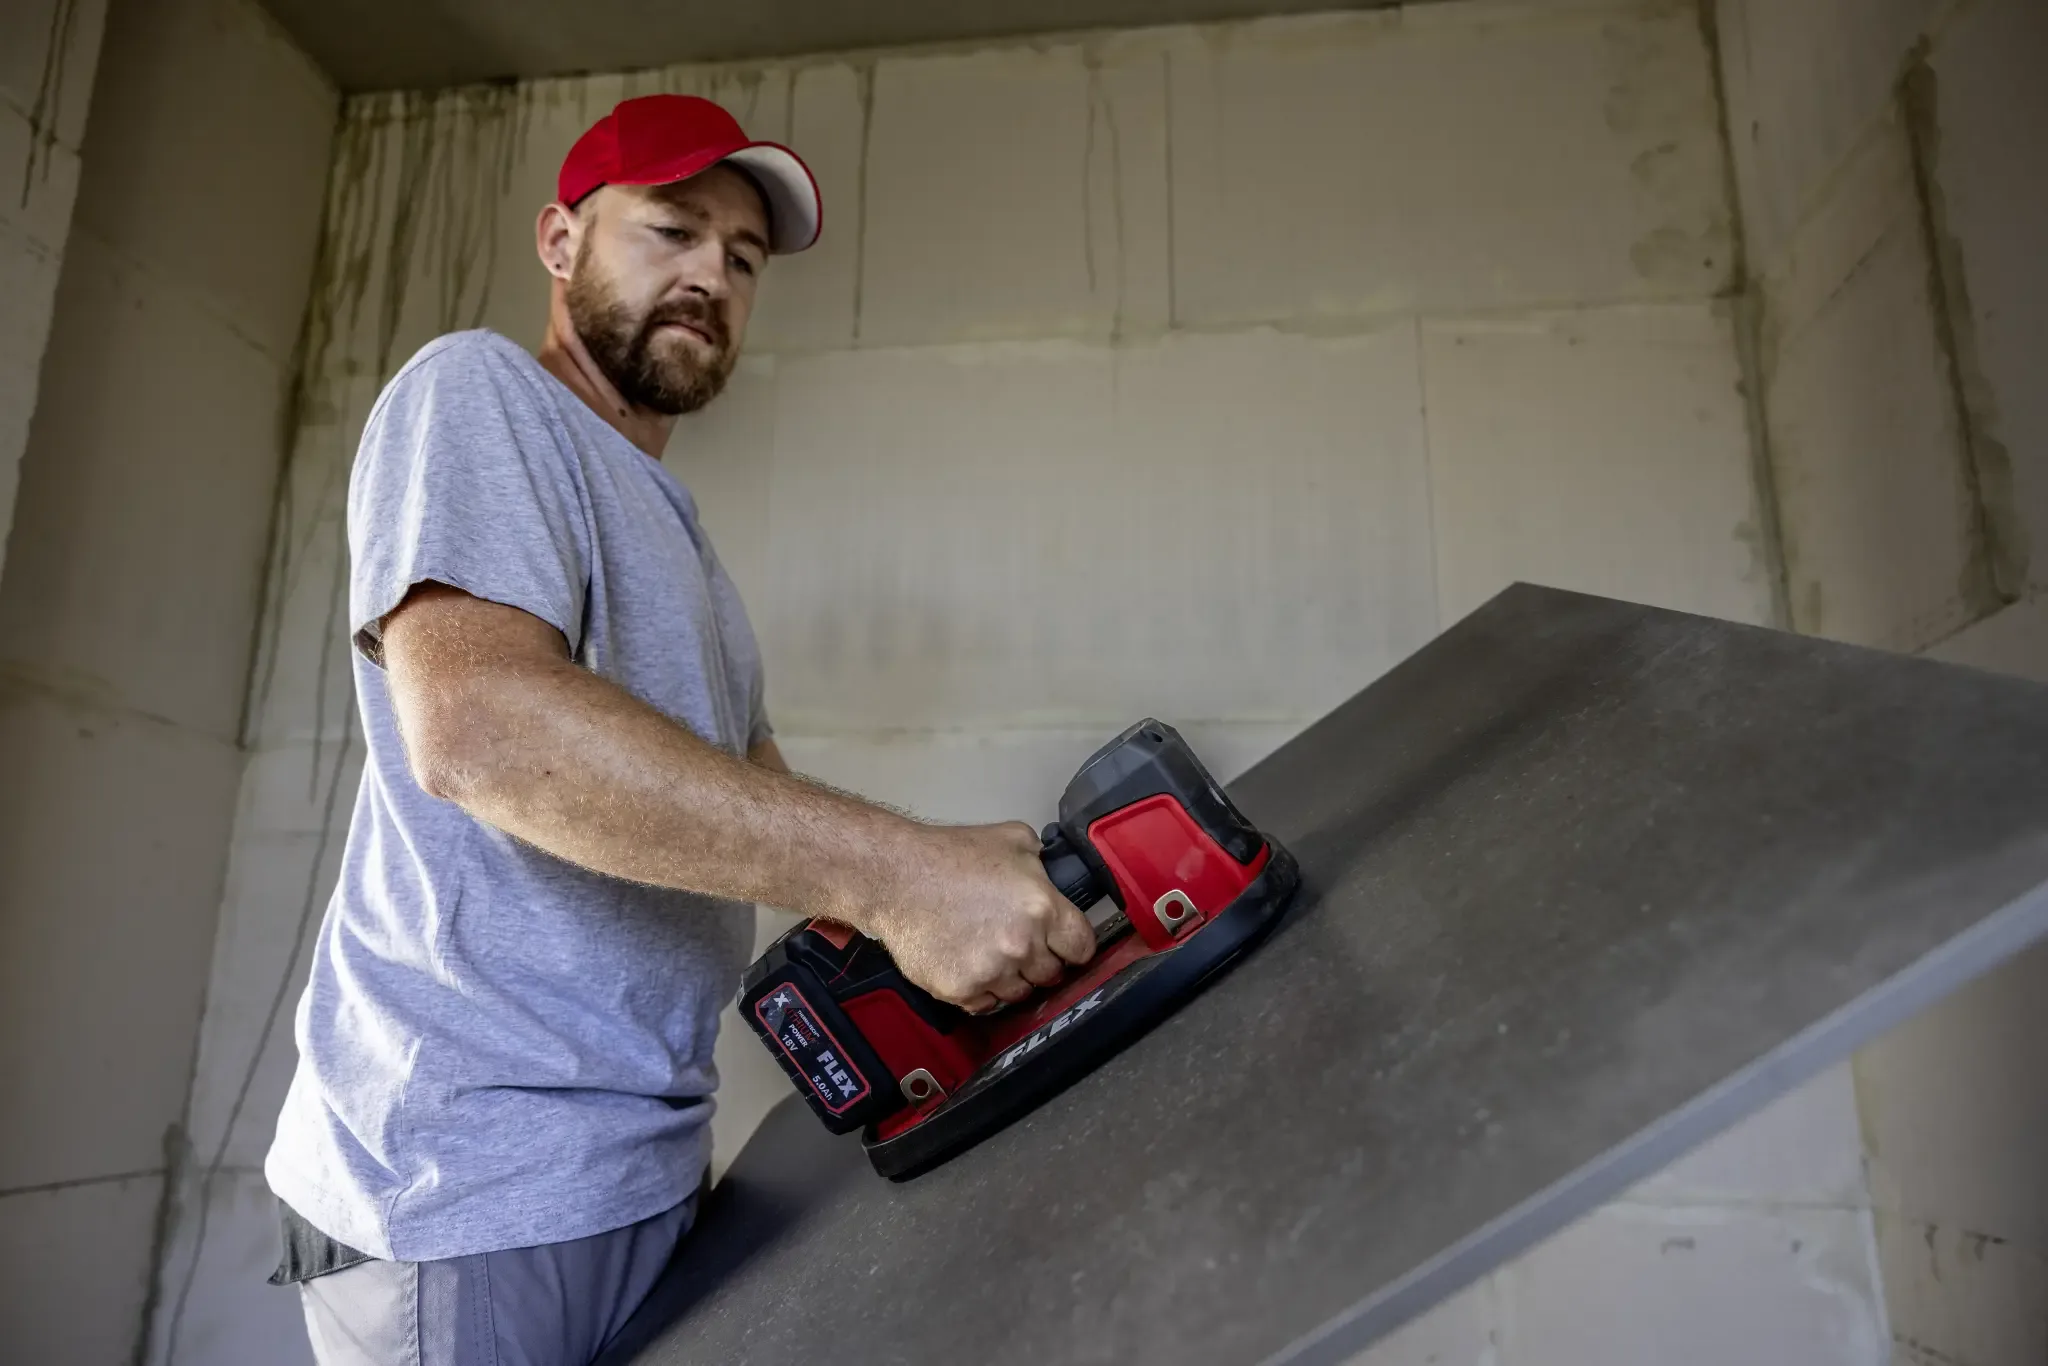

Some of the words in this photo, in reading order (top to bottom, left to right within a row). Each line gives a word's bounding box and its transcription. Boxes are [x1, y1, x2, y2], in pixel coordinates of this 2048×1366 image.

[788, 1023, 808, 1047] POWER
[1002, 988, 1104, 1069] FLEX
[782, 1034, 798, 1051] 18V
[816, 1050, 858, 1098] FLEX
[812, 1075, 833, 1101] 5.0Ah
